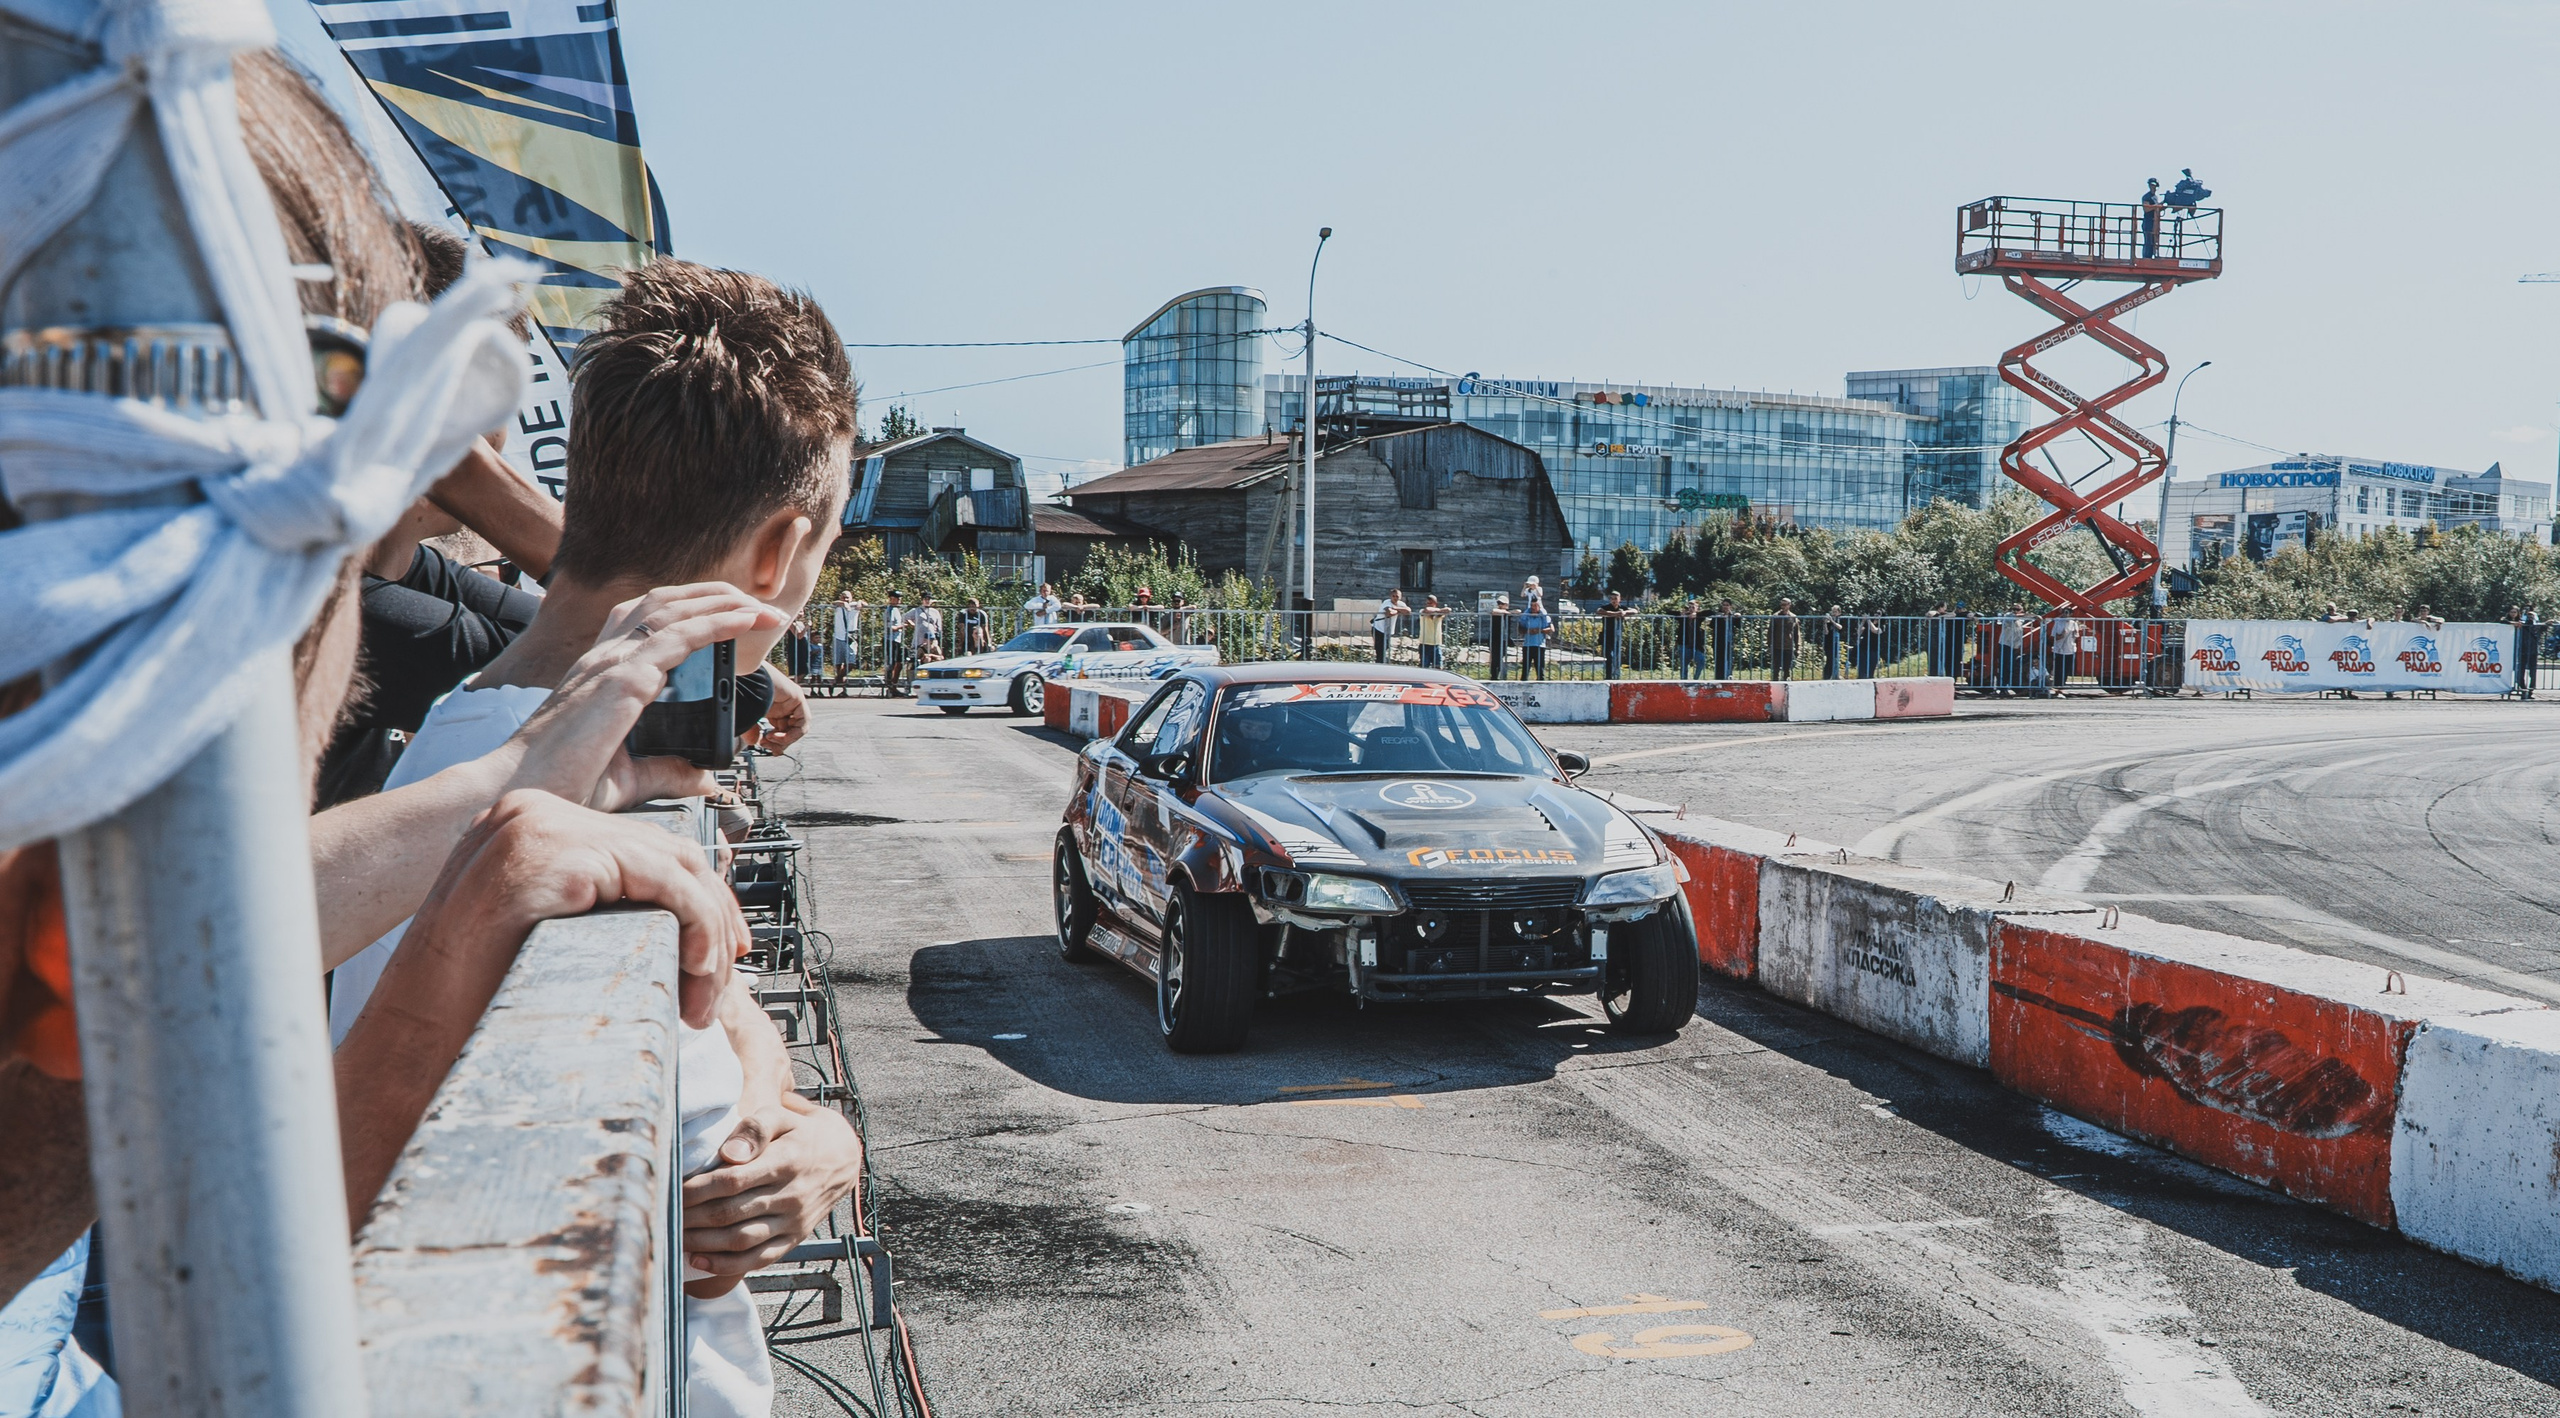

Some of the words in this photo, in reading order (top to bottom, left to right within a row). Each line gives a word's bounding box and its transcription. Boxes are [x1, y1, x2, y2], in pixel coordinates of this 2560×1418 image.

[2034, 322, 2086, 353] АРЕНДА
[2033, 370, 2083, 406] ПРОДАЖА
[2028, 514, 2079, 549] СЕРВИС
[2190, 649, 2223, 661] АВТО
[2261, 650, 2293, 662] АВТО
[2328, 651, 2359, 662] АВТО
[2395, 651, 2426, 662] АВТО
[2458, 651, 2488, 663] АВТО
[2200, 660, 2241, 672] РАДИО
[2271, 661, 2310, 672] РАДИО
[2337, 661, 2376, 673] РАДИО
[2405, 662, 2442, 673] РАДИО
[2467, 662, 2503, 674] РАДИО
[1445, 849, 1575, 860] FOCUS
